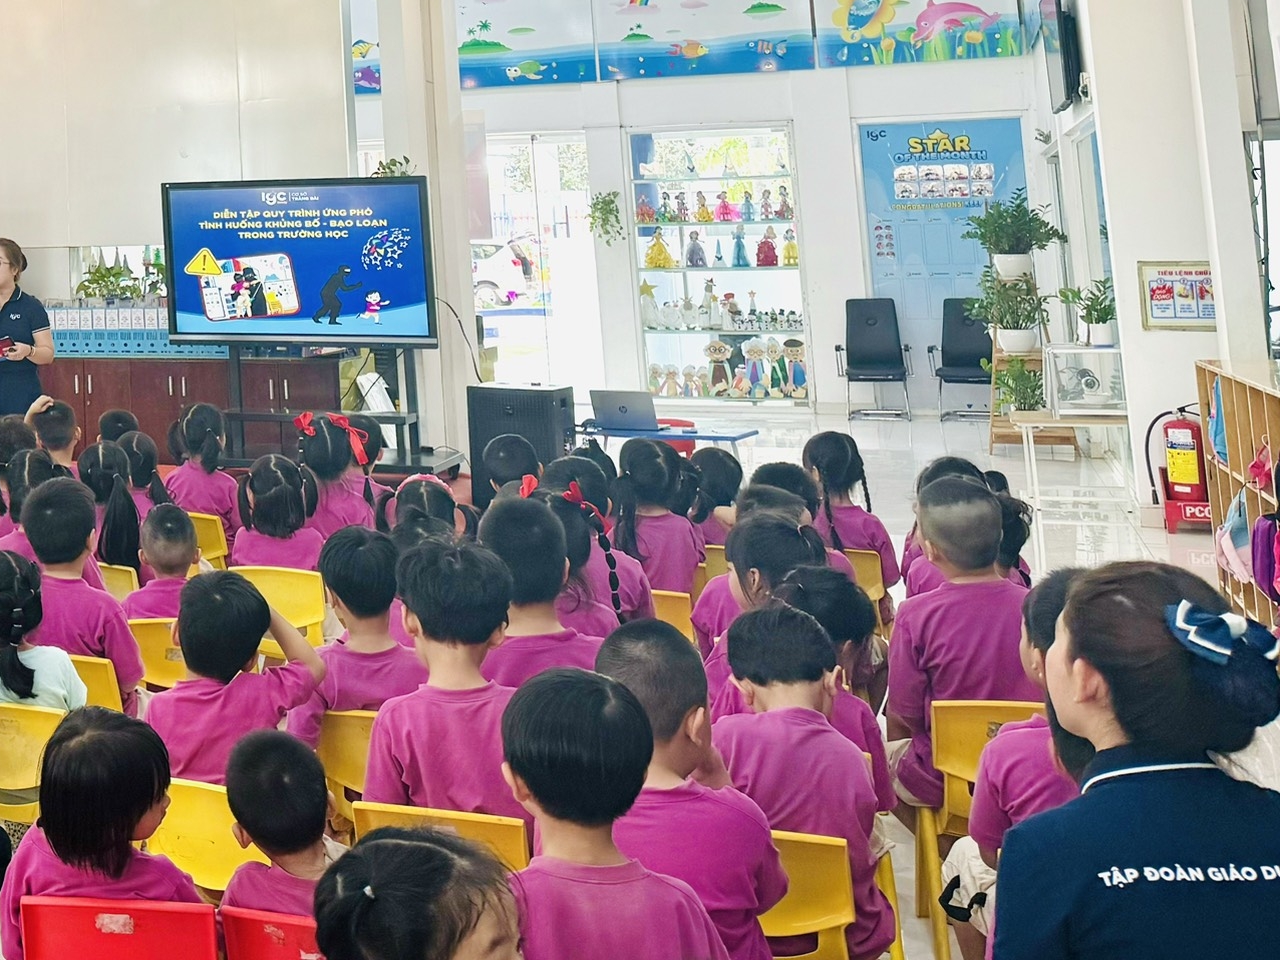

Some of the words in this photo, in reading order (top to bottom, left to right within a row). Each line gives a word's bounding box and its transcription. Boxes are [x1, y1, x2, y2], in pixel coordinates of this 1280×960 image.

[908, 136, 971, 153] STAR
[894, 154, 910, 163] OF
[914, 152, 937, 161] THE
[940, 150, 987, 161] MONTH
[213, 209, 237, 219] DIỄN
[240, 210, 260, 219] TẬP
[288, 209, 320, 217] TRÌNH
[323, 208, 346, 217] ỨNG
[199, 221, 222, 230] TÌNH
[225, 218, 262, 229] HUỐNG
[265, 219, 302, 228] KHỦNG
[305, 218, 320, 227] BỐ
[330, 219, 353, 228] BẠO
[357, 219, 387, 227] LOẠN
[238, 231, 274, 239] TRONG
[277, 229, 322, 238] TRƯỜNG
[326, 231, 348, 239] HỌC
[1098, 866, 1139, 888] TẬP
[1144, 863, 1205, 882] ĐOÀN
[1208, 863, 1257, 882] GIÁO
